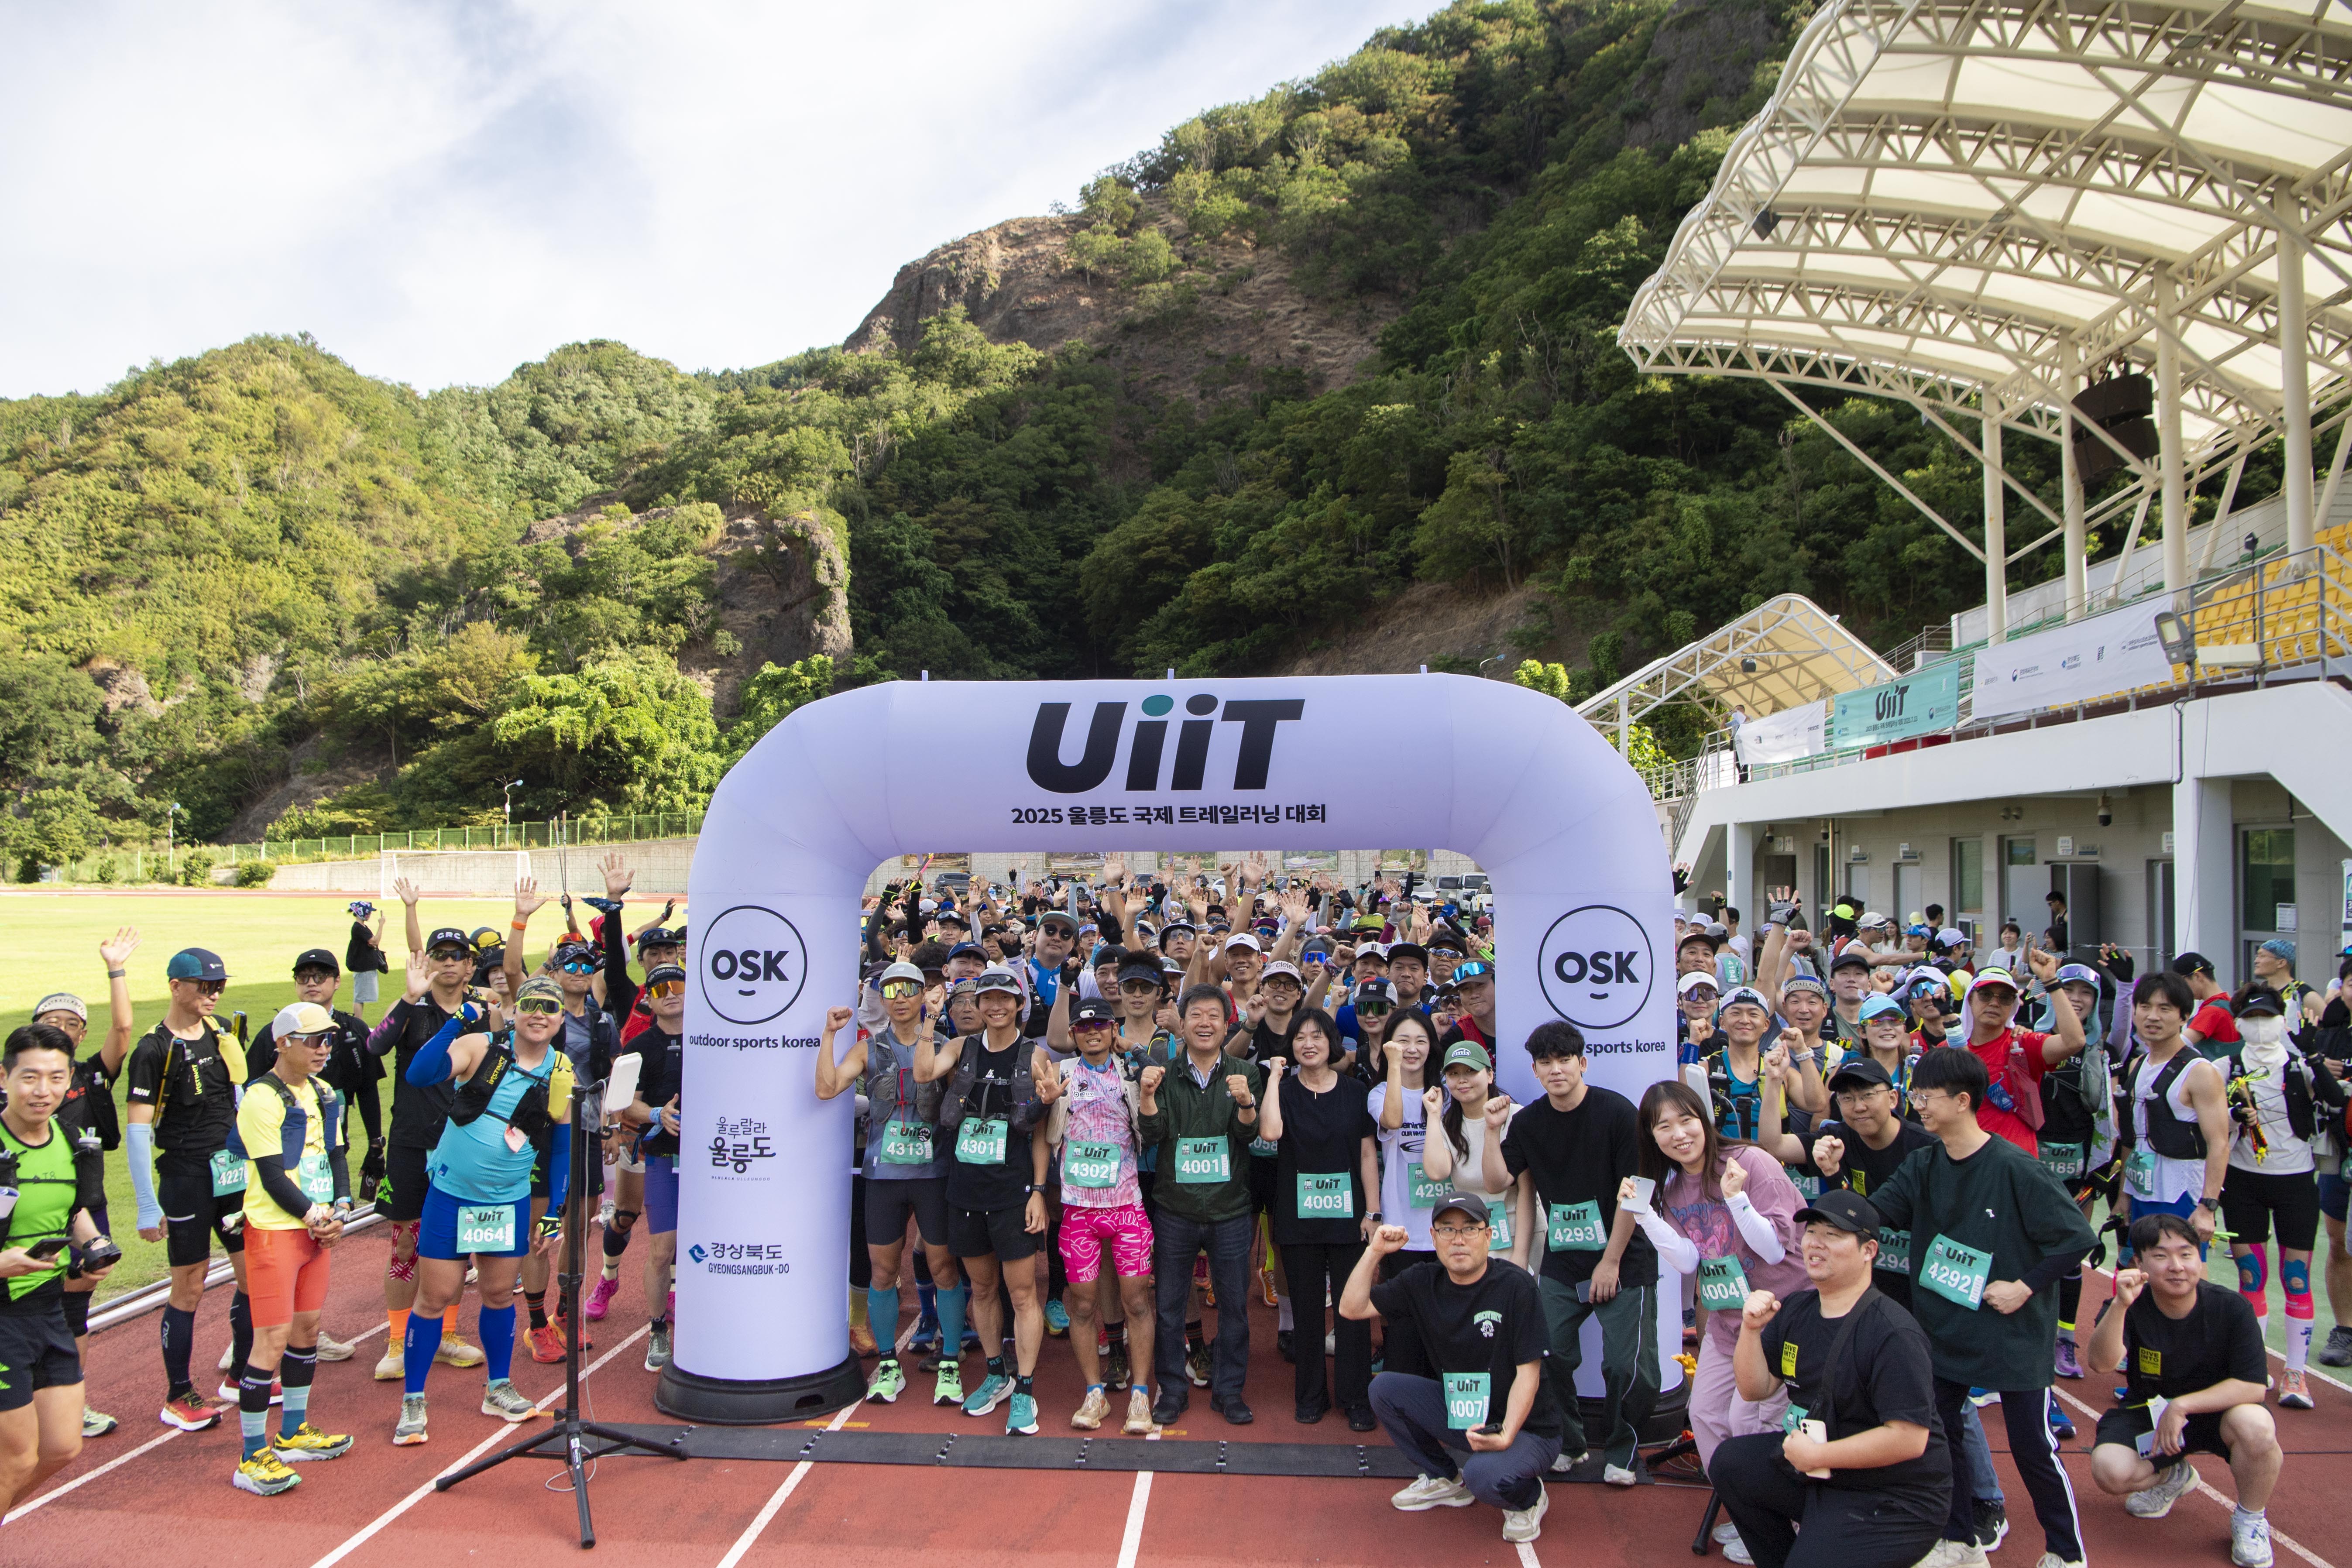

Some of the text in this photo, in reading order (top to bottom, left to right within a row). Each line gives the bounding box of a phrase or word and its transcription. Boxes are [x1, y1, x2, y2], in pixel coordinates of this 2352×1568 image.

[1876, 684, 1910, 721] UiiT
[1027, 693, 1305, 793] UiiT
[1011, 804, 1325, 825] 2025 울릉도 국제 트레일러닝 대회
[438, 931, 461, 940] GRC
[711, 949, 789, 982] OSK
[1555, 951, 1639, 984] OSK
[690, 1034, 821, 1050] outdoor sports korea
[1586, 1039, 1665, 1057] sports korea
[133, 1087, 151, 1097] RUN
[716, 1117, 767, 1139] 울루랄라
[887, 1142, 924, 1156] 4313
[961, 1139, 994, 1155] 4301
[1193, 1142, 1218, 1154] UiiT
[1250, 1136, 1277, 1151] 058
[708, 1136, 776, 1173] 울릉도
[1084, 1146, 1110, 1158] UiiT
[1069, 1162, 1109, 1178] 4302
[1181, 1159, 1219, 1174] 4001
[220, 1168, 244, 1186] 4227
[1315, 1178, 1340, 1190] UiiT
[1415, 1182, 1452, 1199] 4295
[1303, 1195, 1343, 1210] 4003
[478, 1211, 505, 1222] UiiT
[1562, 1208, 1588, 1221] UiiT
[464, 1228, 505, 1242] 4064
[1554, 1226, 1595, 1242] 4293
[1879, 1233, 1910, 1248] UiiT
[711, 1242, 782, 1260] 경상북도
[1945, 1246, 1977, 1267] UiiT
[708, 1263, 789, 1275] GYEONGSANGBUK-DO
[1878, 1252, 1910, 1271] 294
[1703, 1264, 1727, 1277] UiiT
[1927, 1262, 1971, 1294] 4292
[1702, 1280, 1740, 1300] 4004
[1783, 1350, 1796, 1359] INTO
[1784, 1344, 1796, 1353] DIVE
[2140, 1349, 2158, 1357] DIVE
[2140, 1354, 2158, 1362] INTO
[1457, 1379, 1480, 1392] UiiT
[1450, 1400, 1483, 1418] 4007
